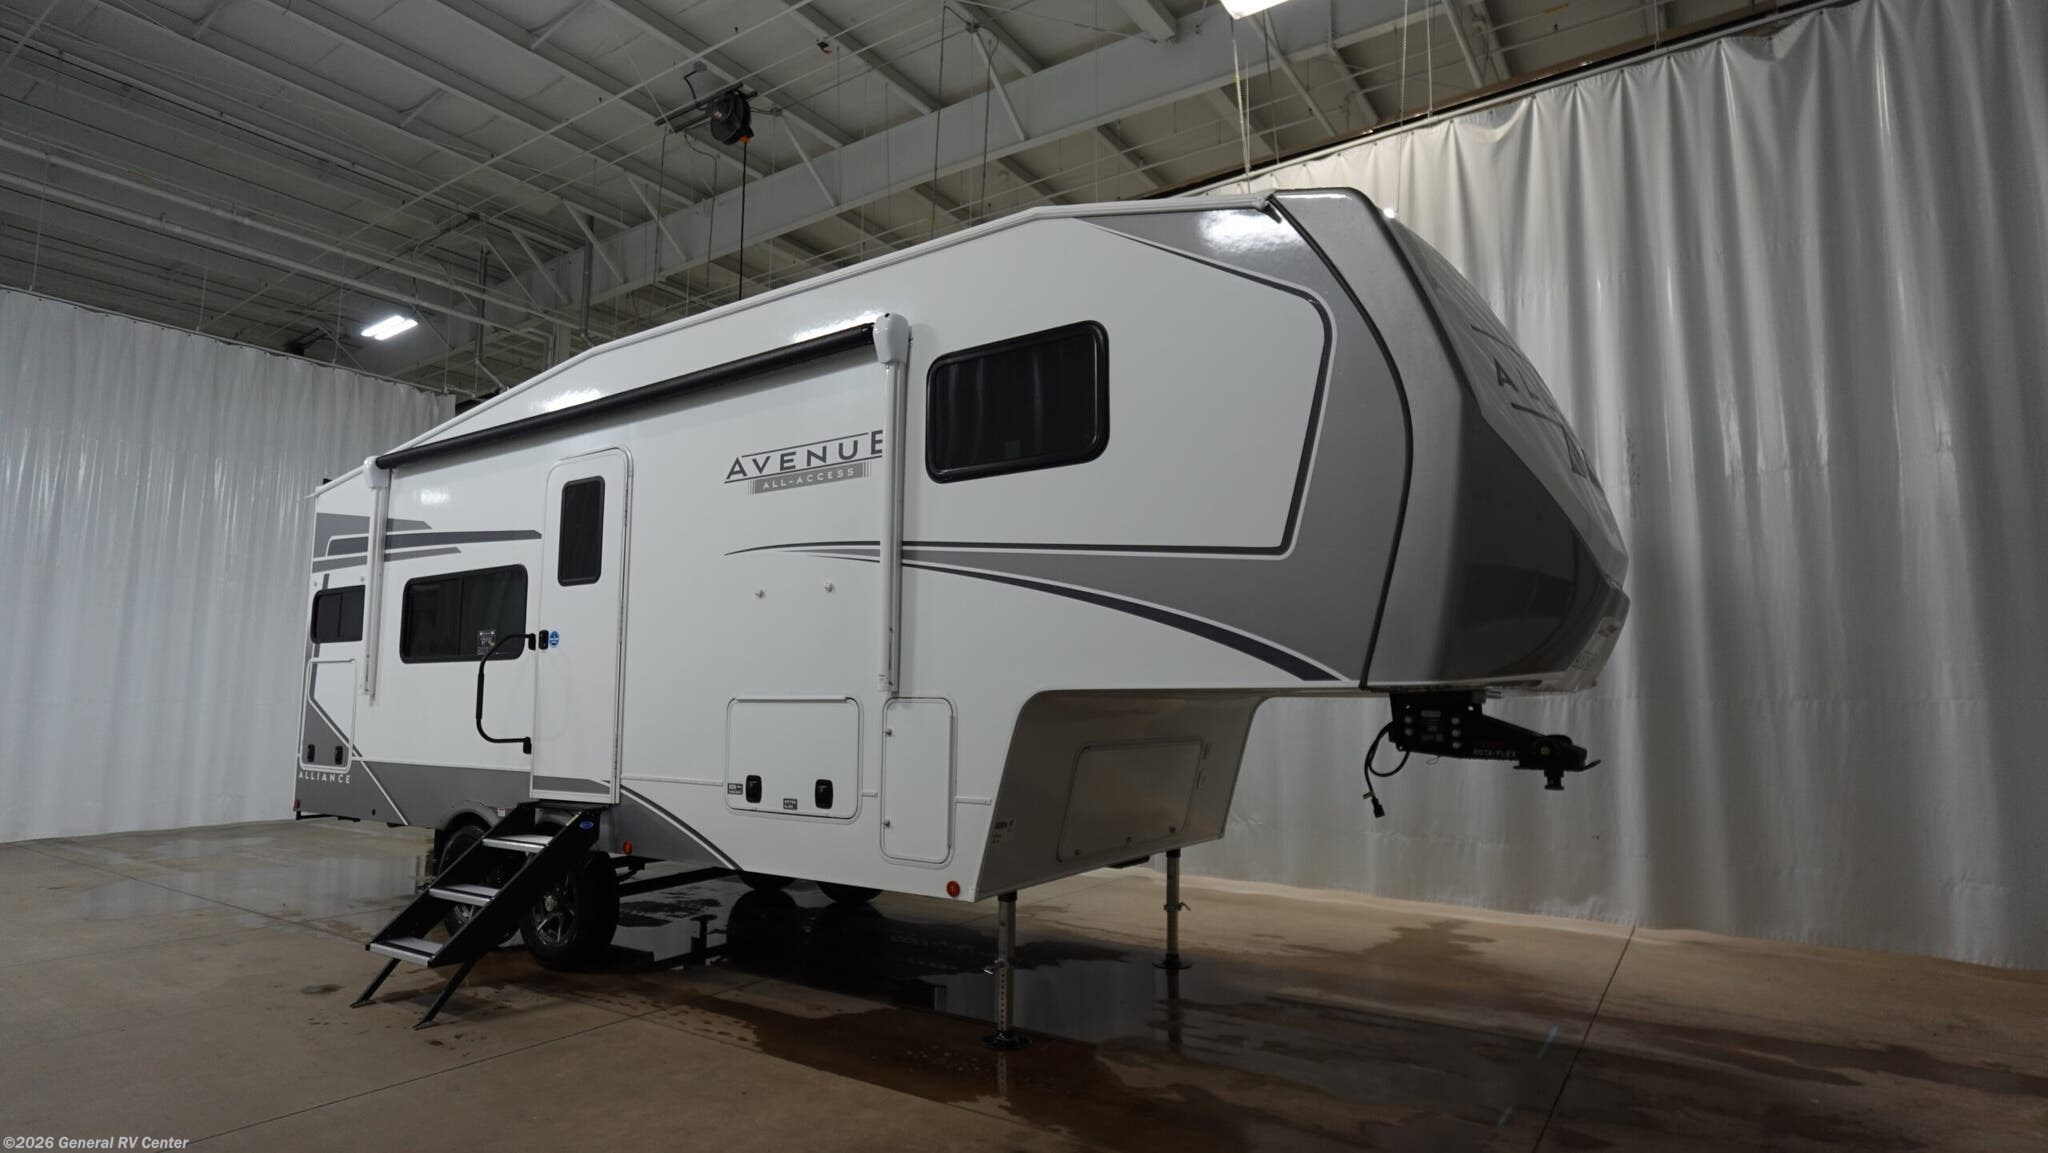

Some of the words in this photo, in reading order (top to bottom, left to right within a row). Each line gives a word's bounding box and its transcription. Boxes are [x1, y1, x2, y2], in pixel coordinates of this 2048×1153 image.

[726, 429, 883, 480] AVENUE
[763, 467, 855, 489] ALL-ACCESS
[298, 771, 351, 784] ALLIANCE
